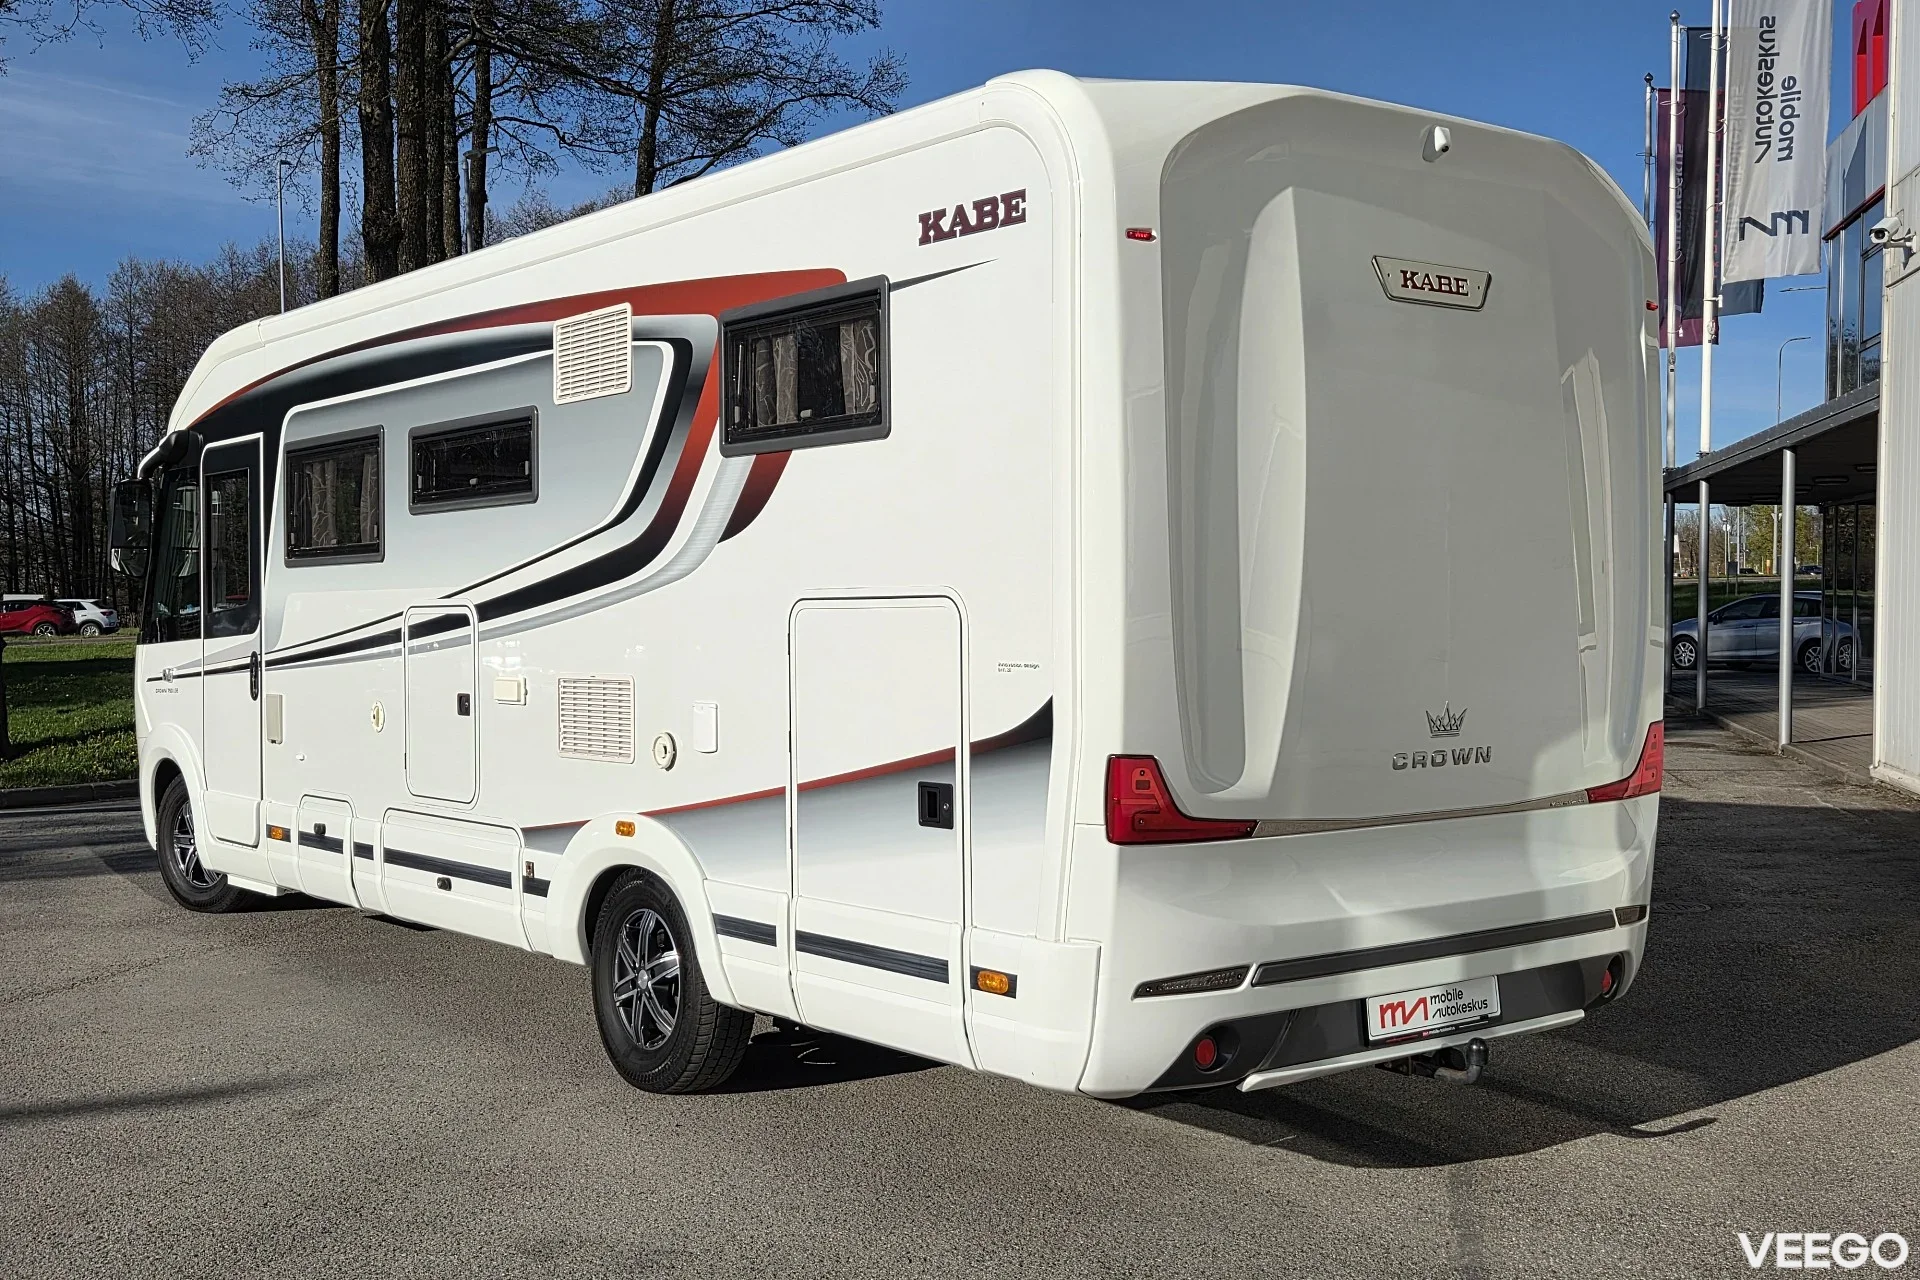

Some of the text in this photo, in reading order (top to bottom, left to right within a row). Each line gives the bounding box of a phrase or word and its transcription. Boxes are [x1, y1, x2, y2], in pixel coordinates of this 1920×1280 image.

[918, 188, 1026, 246] KABE
[1400, 269, 1469, 296] KABE
[1392, 745, 1492, 770] CROWN
[1430, 988, 1463, 1005] mobile
